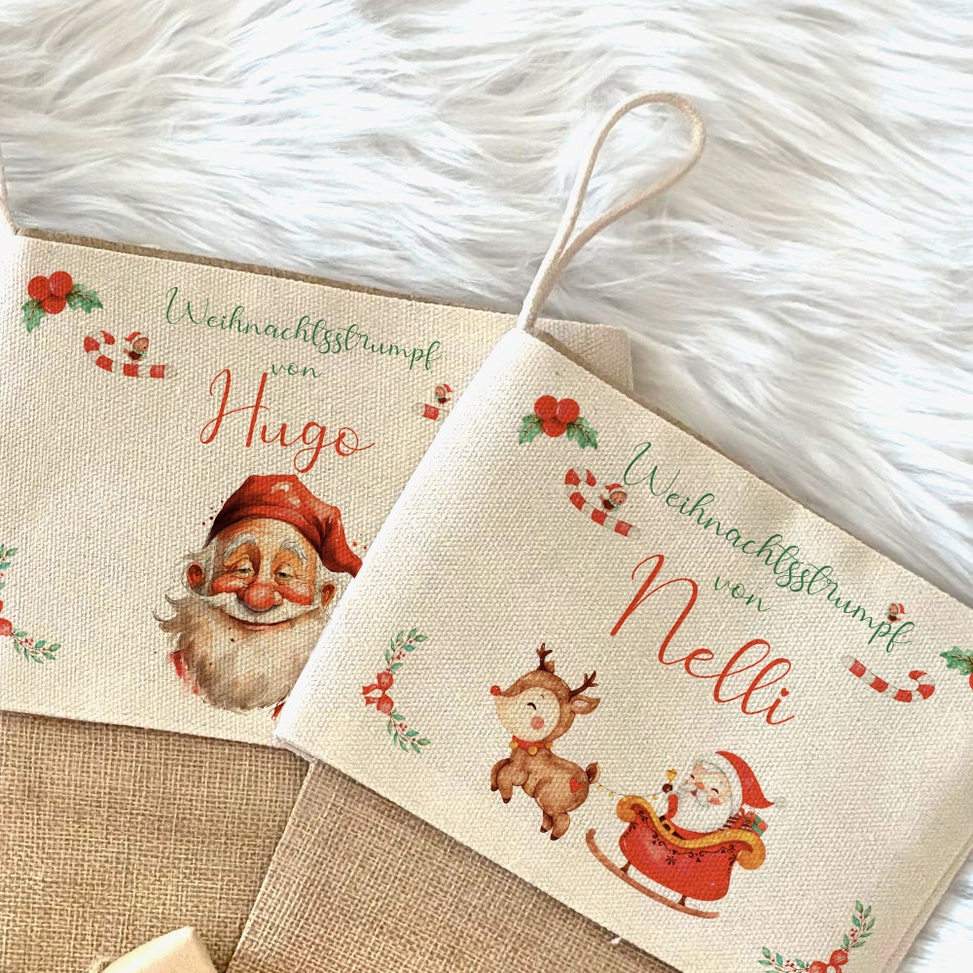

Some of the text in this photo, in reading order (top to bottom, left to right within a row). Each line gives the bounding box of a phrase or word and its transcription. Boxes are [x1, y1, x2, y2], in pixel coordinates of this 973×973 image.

[165, 286, 442, 370] Weihnachtsstrumpf
[271, 362, 322, 378] von
[199, 368, 375, 473] Hugo
[623, 441, 915, 653] Weihnachtsstrumpf
[713, 576, 770, 612] von
[610, 554, 795, 725] Nelli
